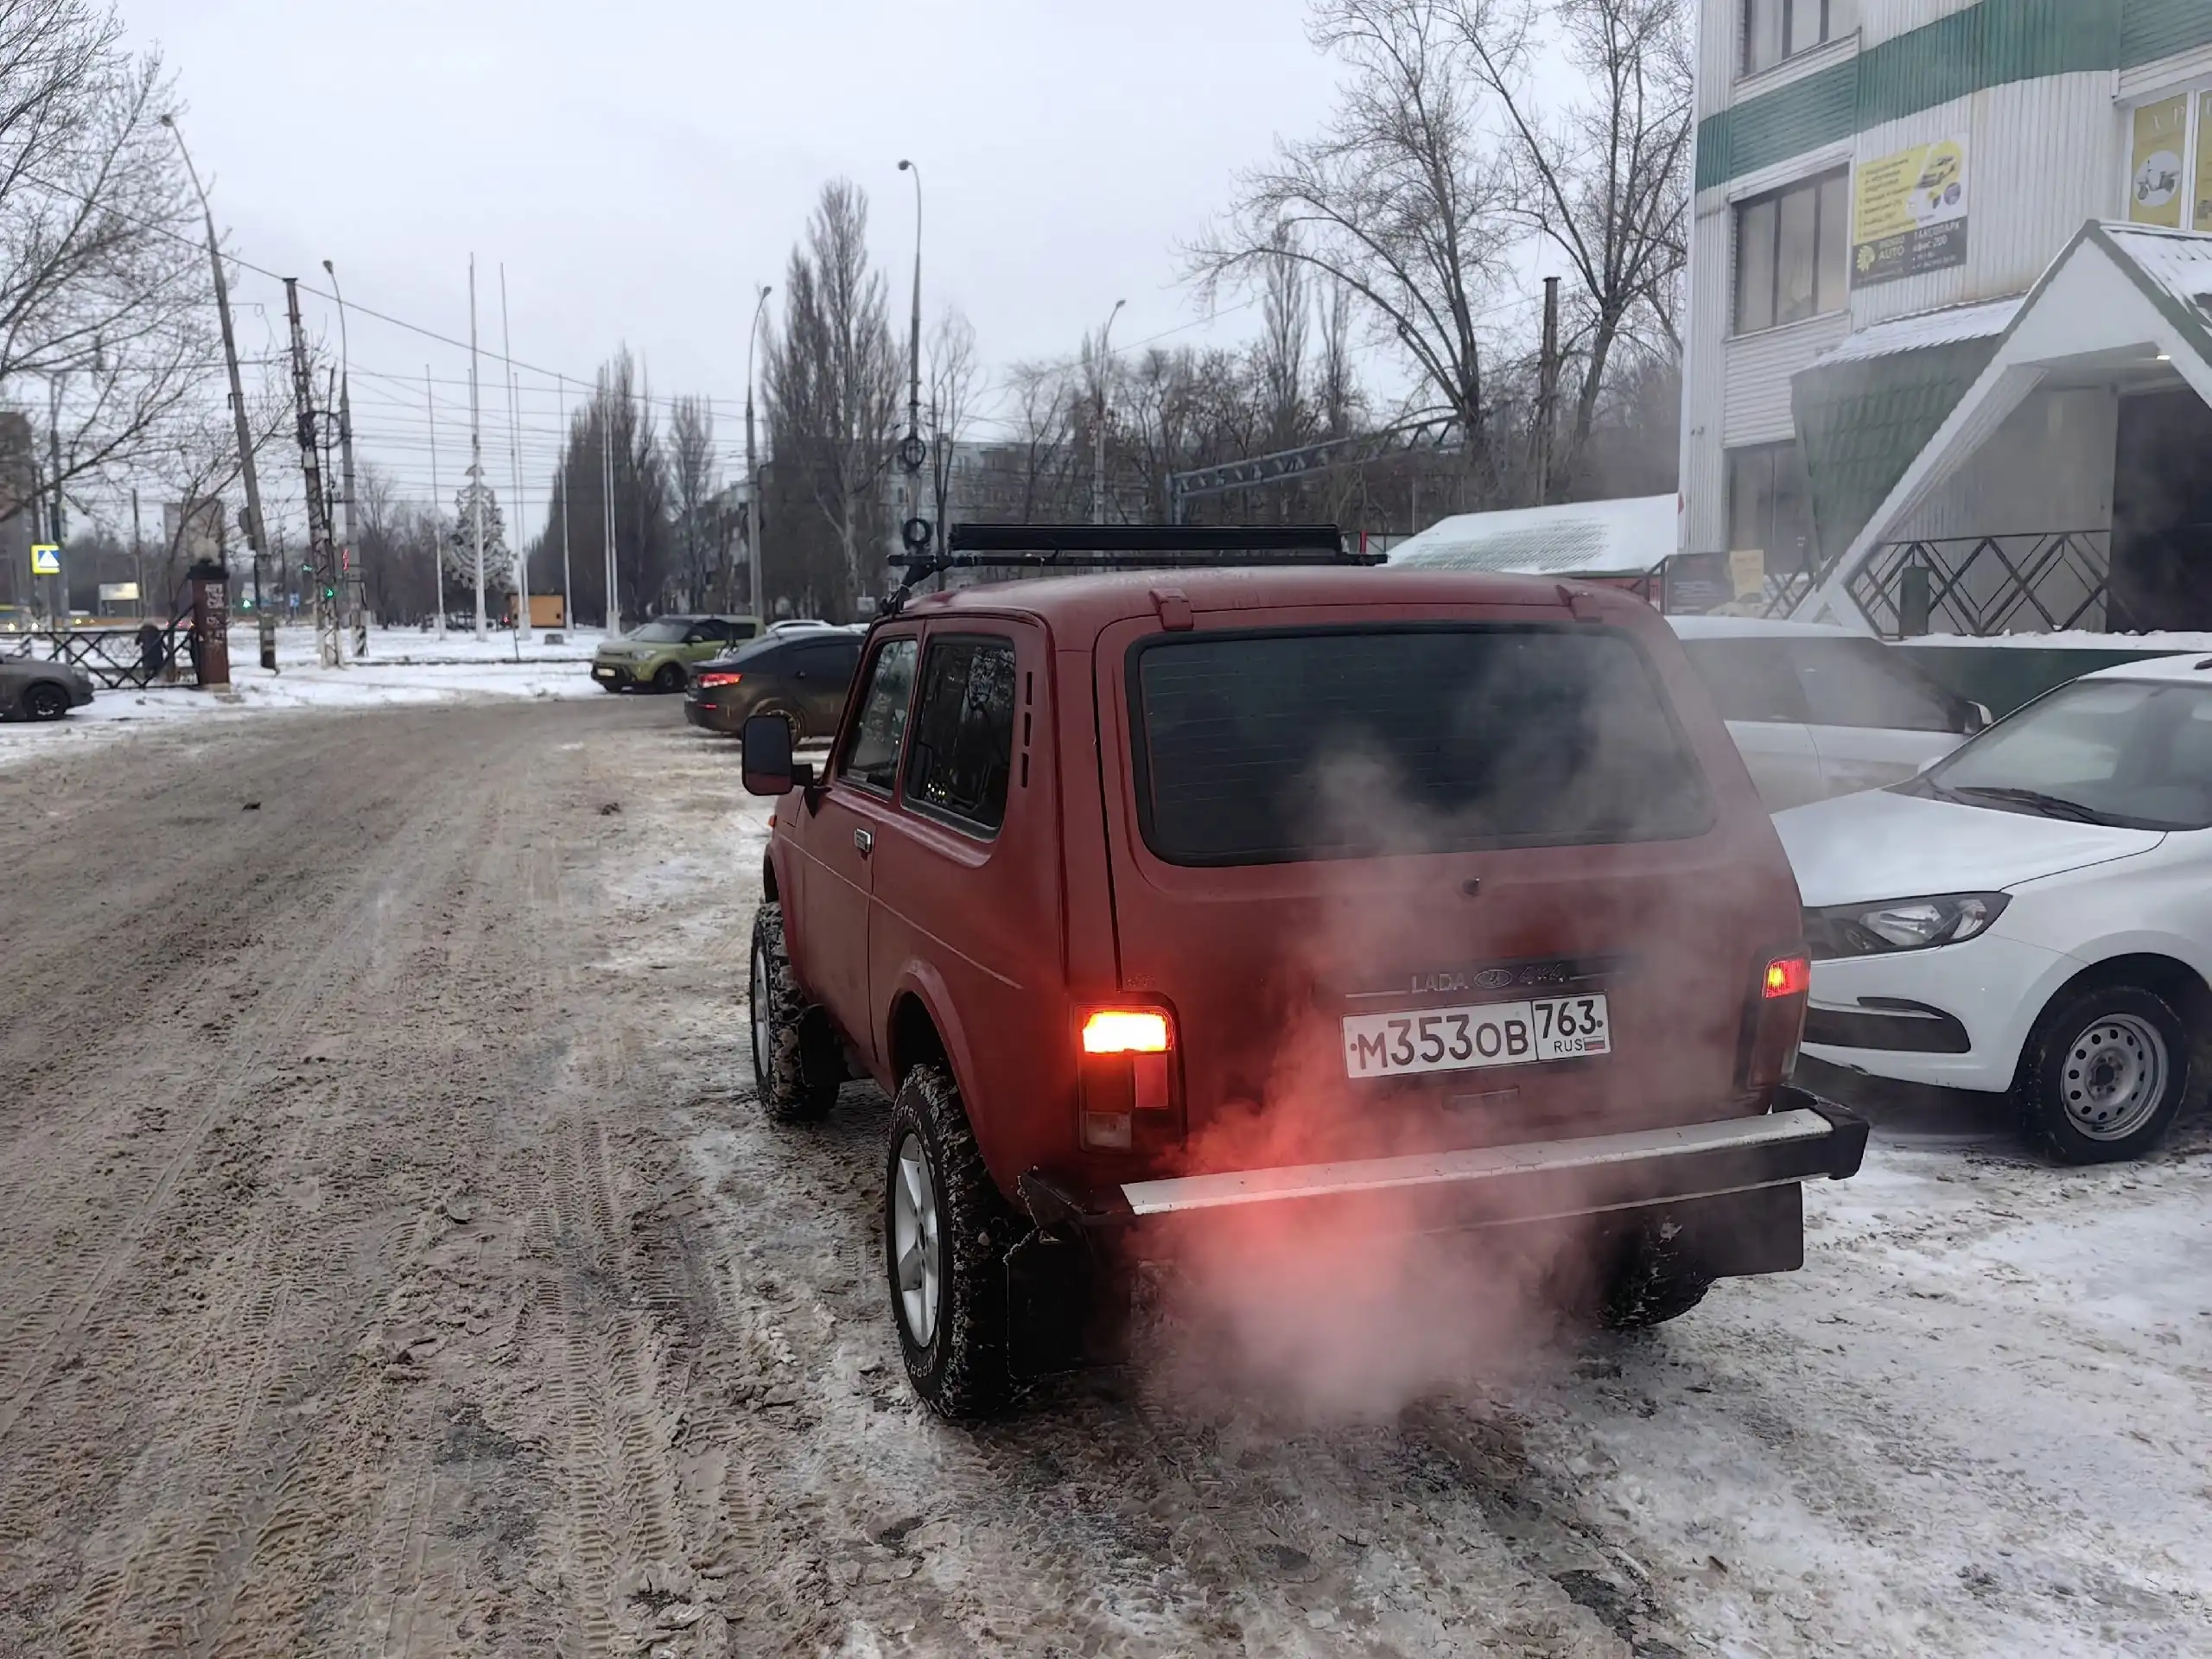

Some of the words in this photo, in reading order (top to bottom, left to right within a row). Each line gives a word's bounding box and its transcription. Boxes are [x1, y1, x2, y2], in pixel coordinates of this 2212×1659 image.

[1411, 972, 1468, 993] LADA
[1357, 1014, 1529, 1070] М353ОВ
[1535, 999, 1596, 1039] 763
[1554, 1038, 1583, 1053] RUS
